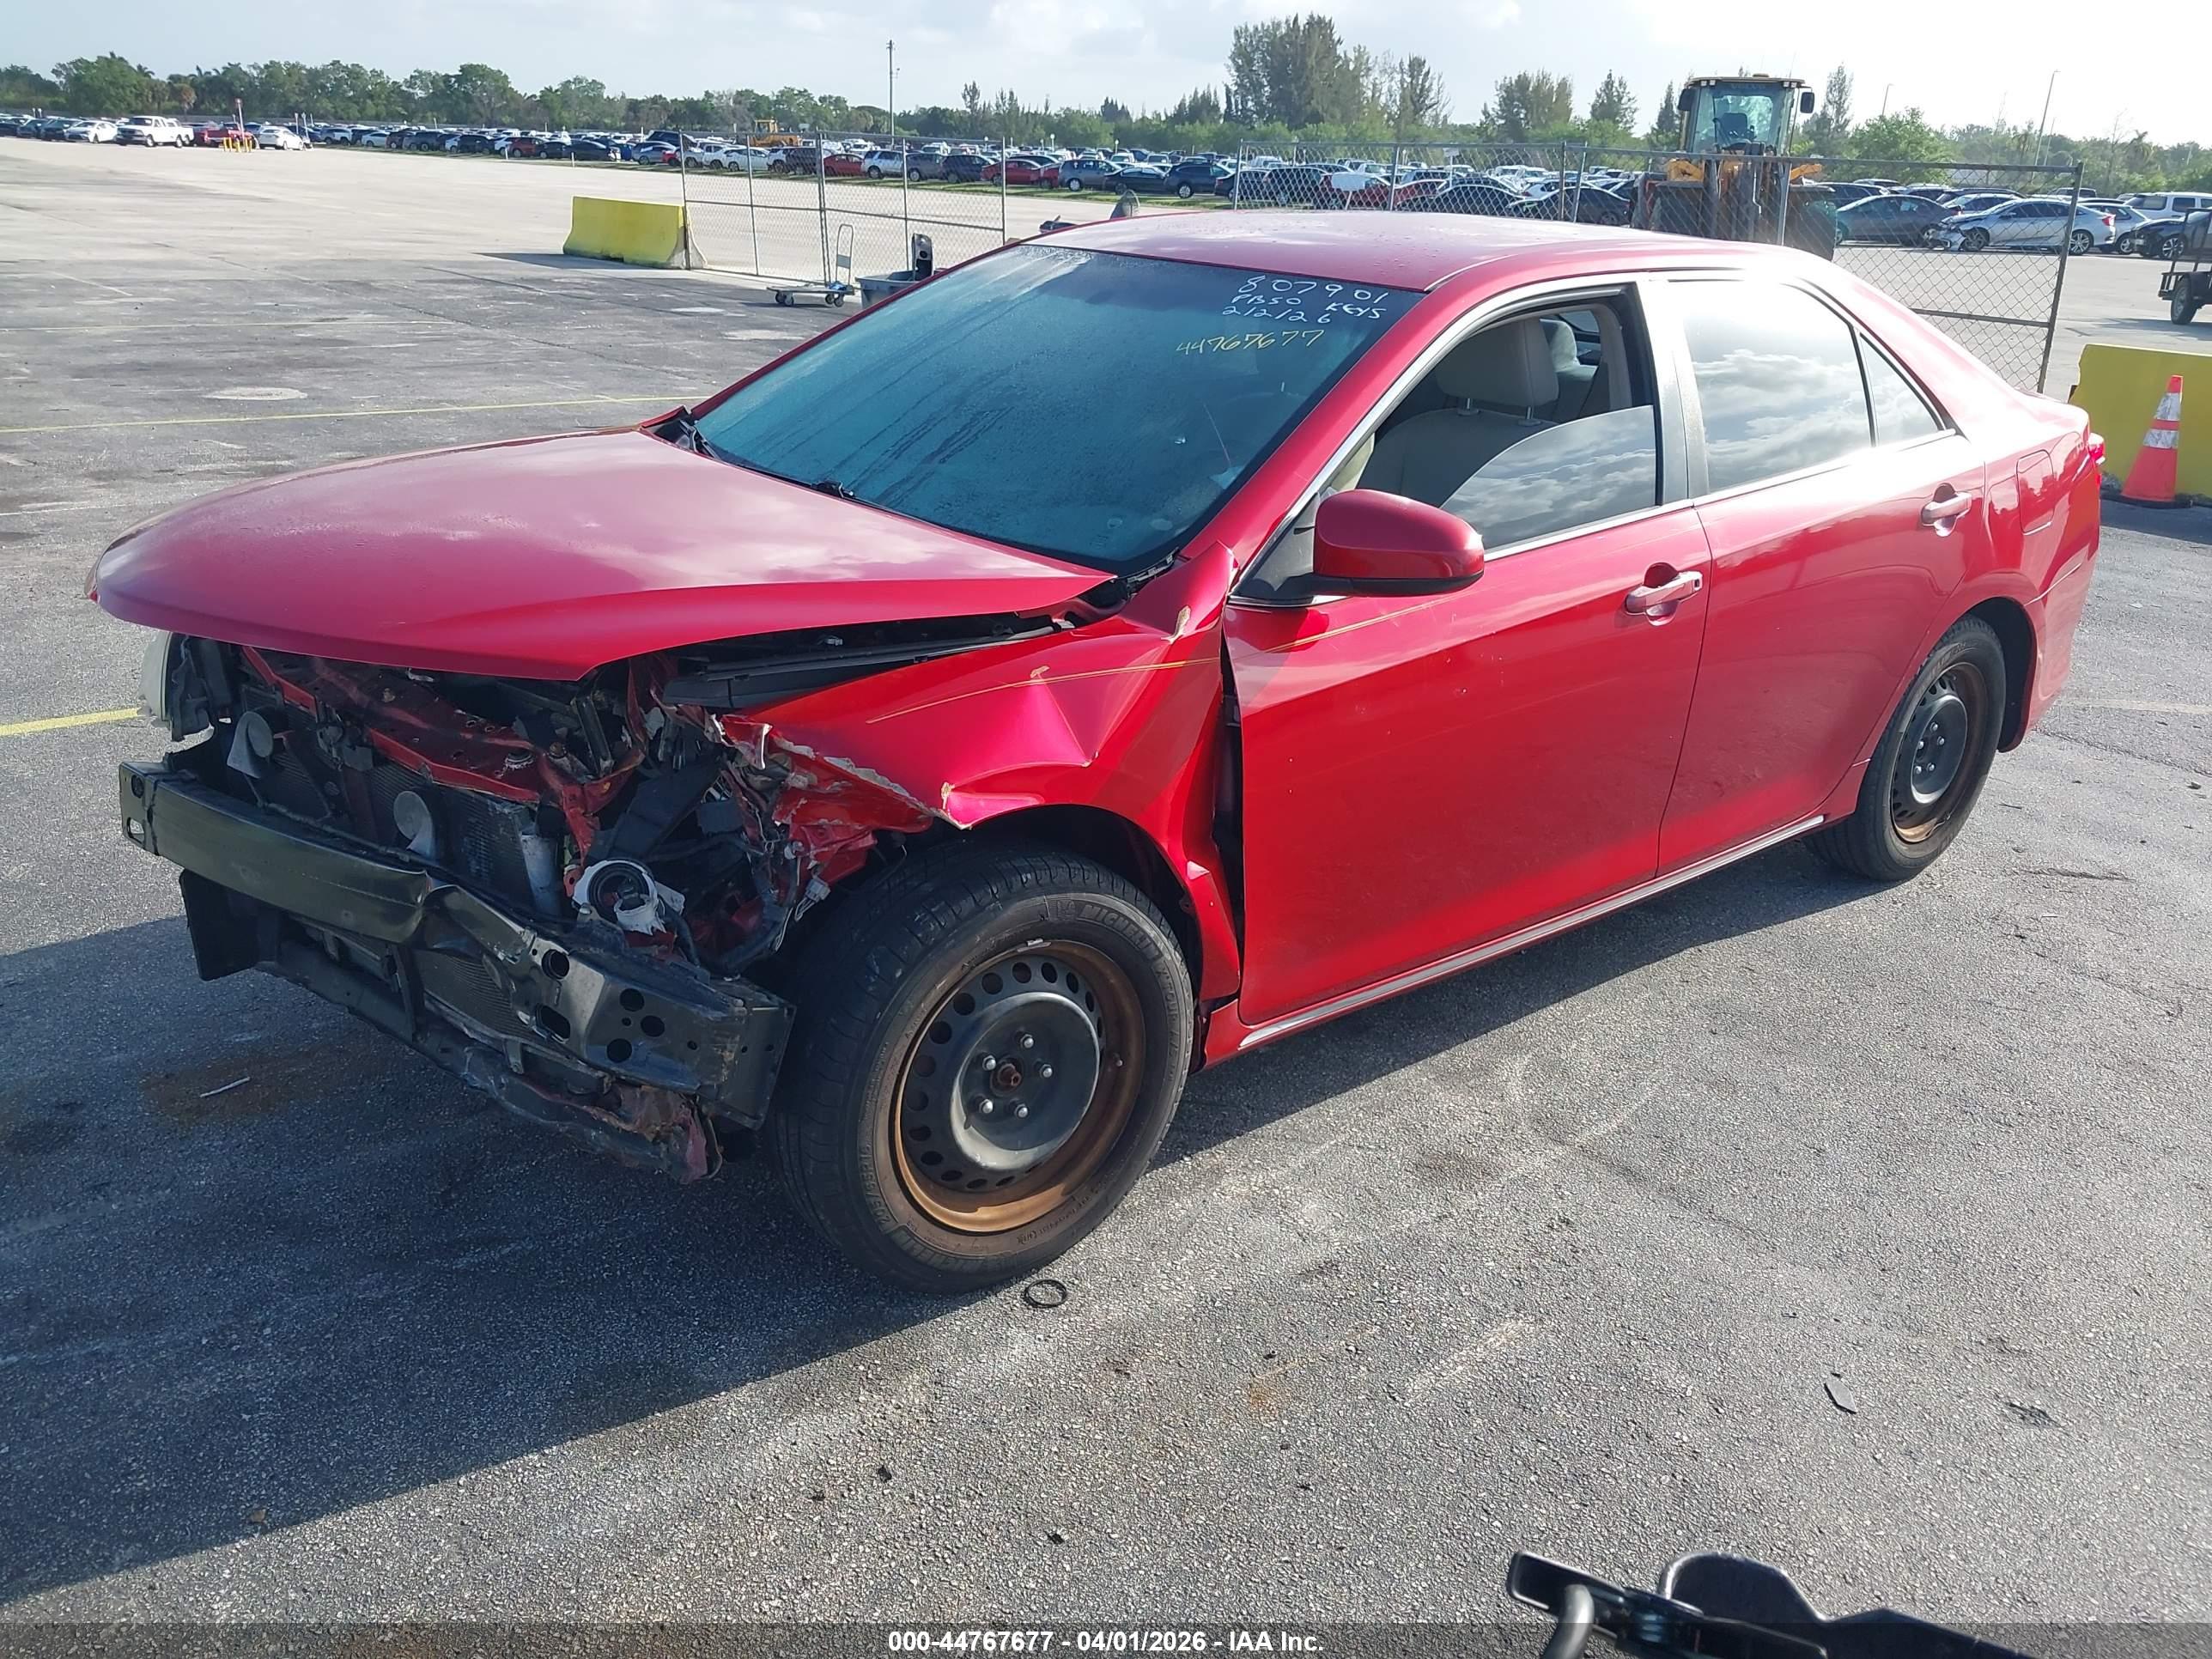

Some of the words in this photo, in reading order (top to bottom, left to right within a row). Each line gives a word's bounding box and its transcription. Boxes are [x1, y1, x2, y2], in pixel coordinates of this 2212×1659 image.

[1325, 301, 1387, 319] KEYS
[1176, 329, 1325, 356] 44767677
[1079, 904, 1159, 960] MICHELIN
